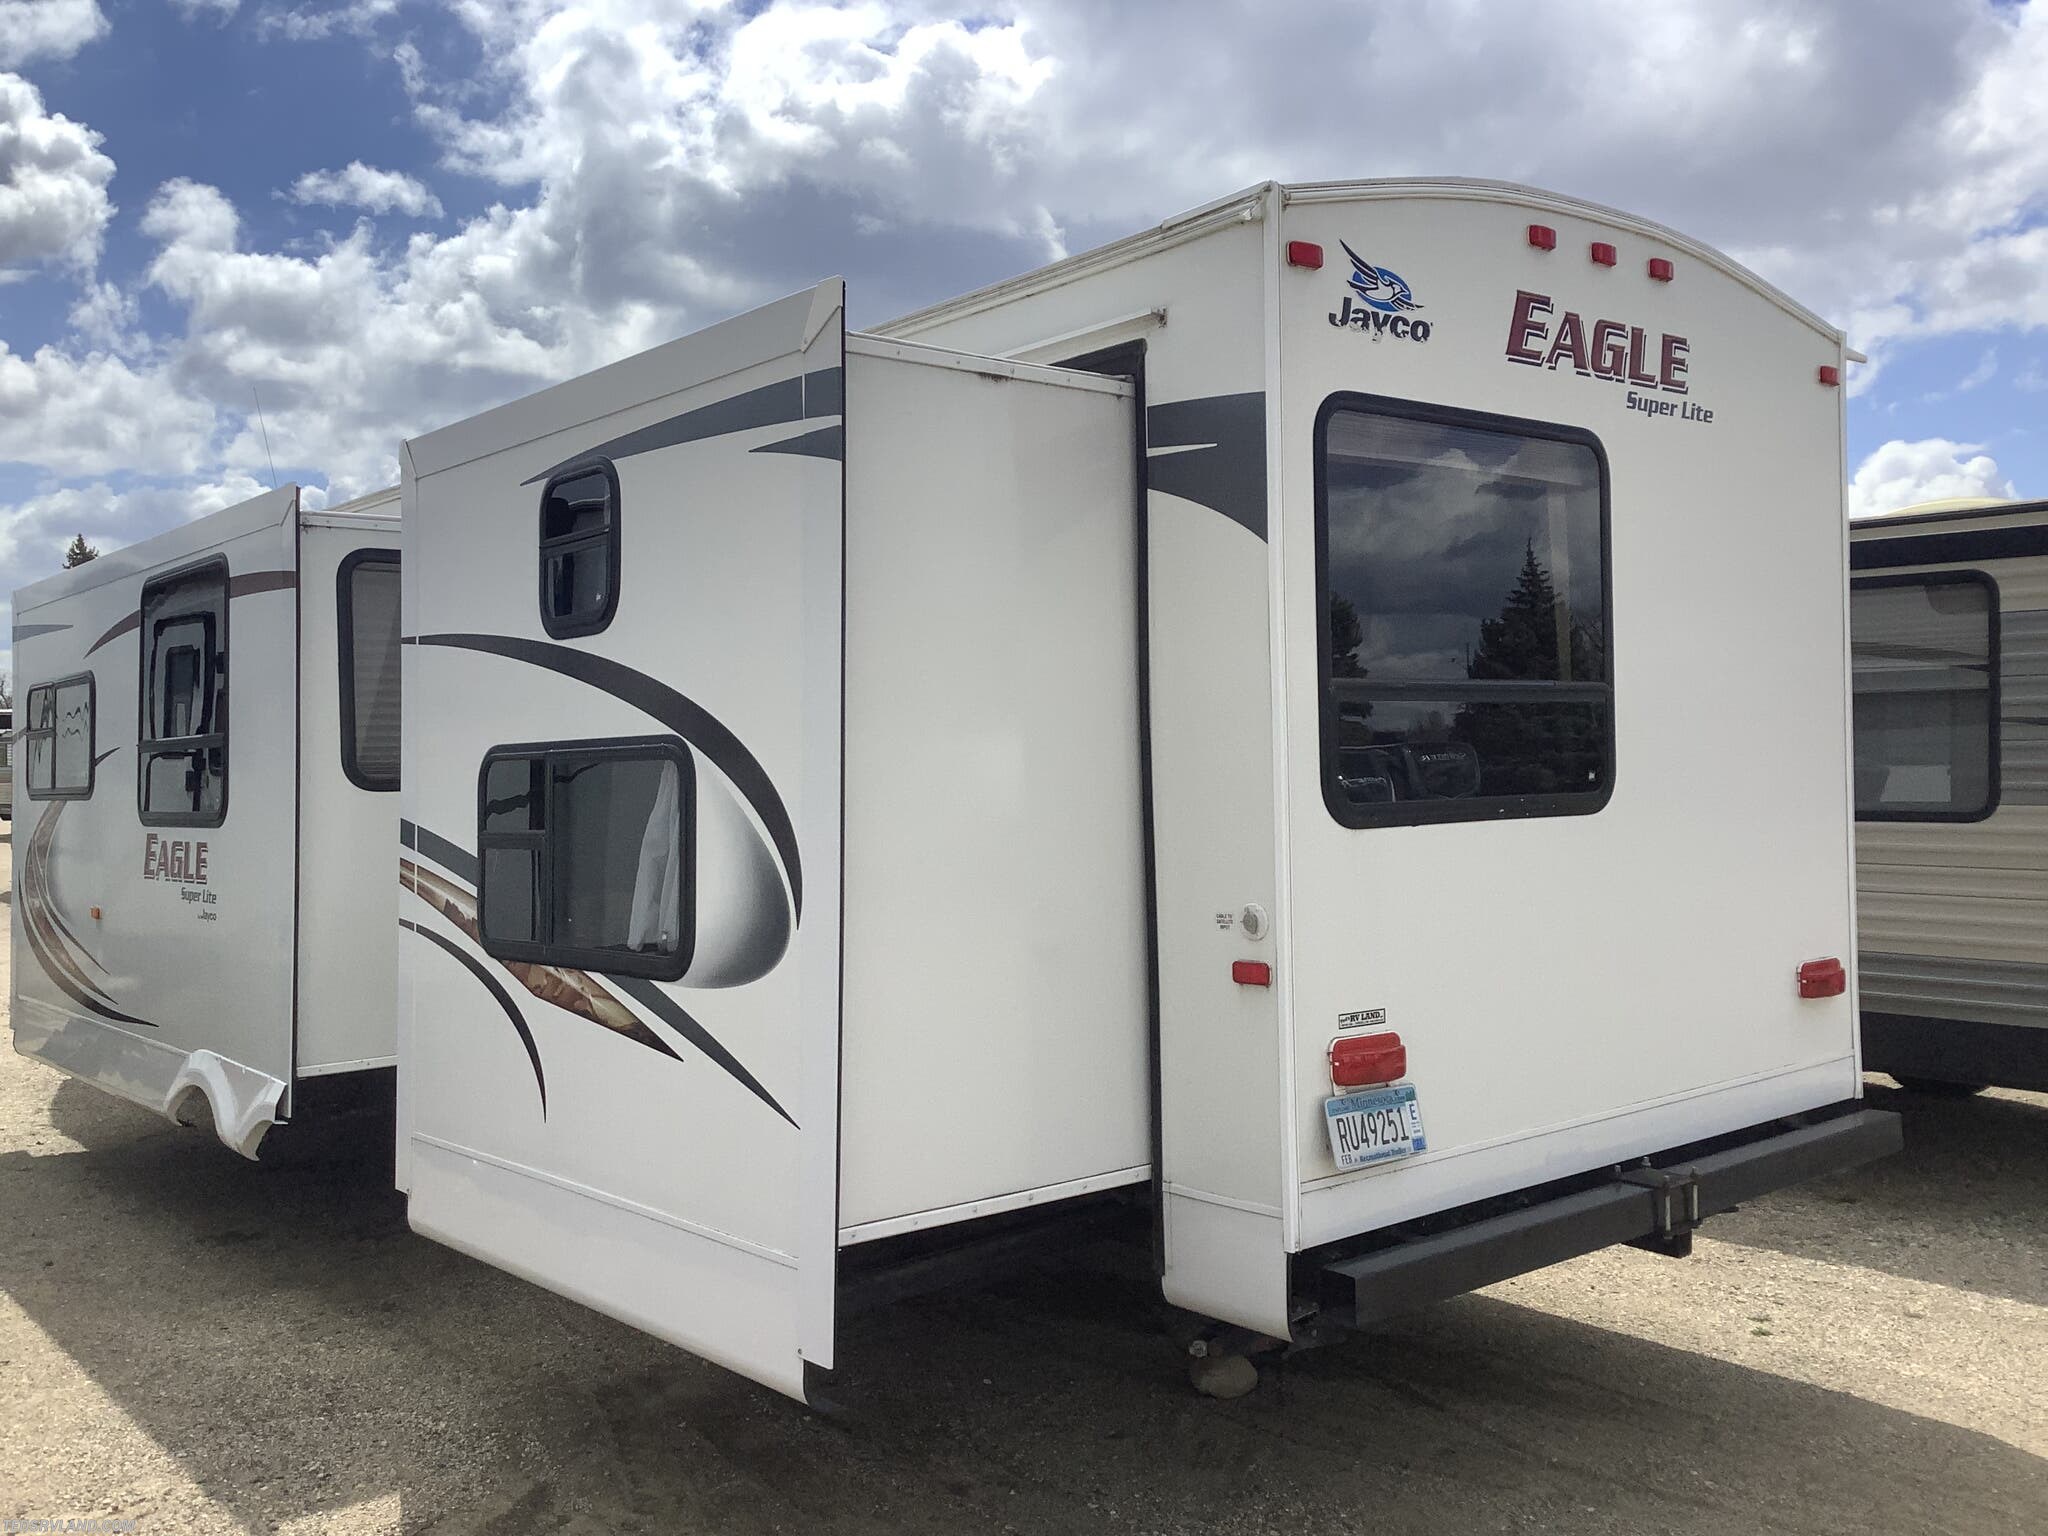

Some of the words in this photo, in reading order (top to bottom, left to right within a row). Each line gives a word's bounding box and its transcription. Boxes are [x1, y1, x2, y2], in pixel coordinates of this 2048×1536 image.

[1329, 297, 1433, 342] Jayco
[1505, 289, 1690, 394] EAGLE
[1627, 391, 1678, 421] Super
[1682, 400, 1714, 423] Lite
[143, 833, 209, 885] EAGLE
[181, 887, 201, 904] Super
[202, 887, 217, 905] Lite
[1350, 1013, 1360, 1022] RV
[1336, 1107, 1410, 1154] RU49251
